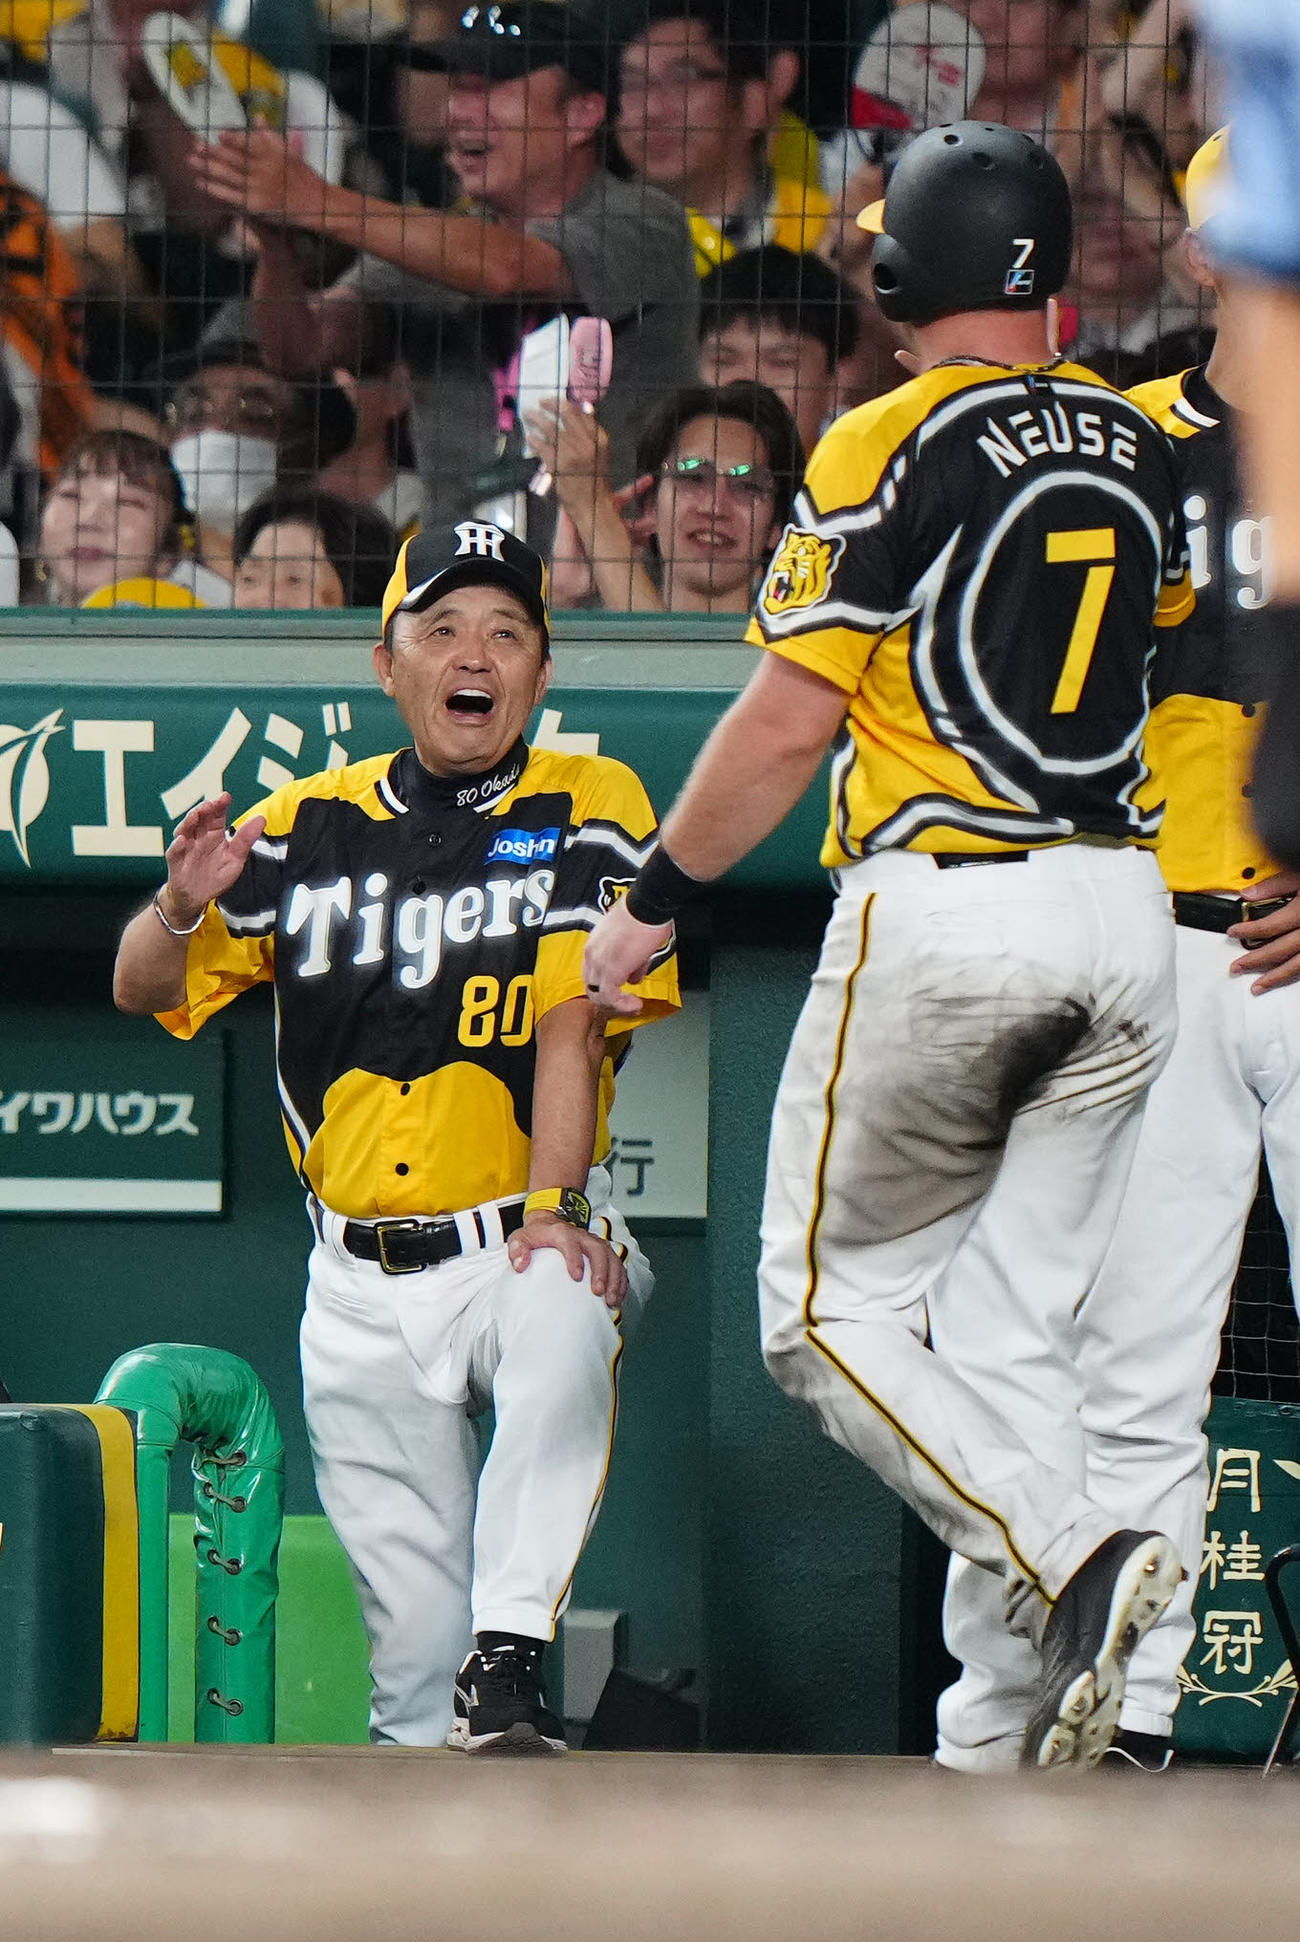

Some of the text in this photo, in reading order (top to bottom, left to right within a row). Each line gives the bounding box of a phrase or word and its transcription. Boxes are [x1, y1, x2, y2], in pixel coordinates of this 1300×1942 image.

[1012, 238, 1035, 269] 7
[976, 400, 1138, 479] NEUSE
[1045, 527, 1116, 715] 7
[456, 763, 521, 807] 80 Okad
[487, 837, 556, 858] Joshn
[286, 869, 555, 989] Tigers
[457, 974, 536, 1048] 80
[0, 1090, 200, 1136] イワハウス
[1200, 1448, 1266, 1675] 月桂冠
